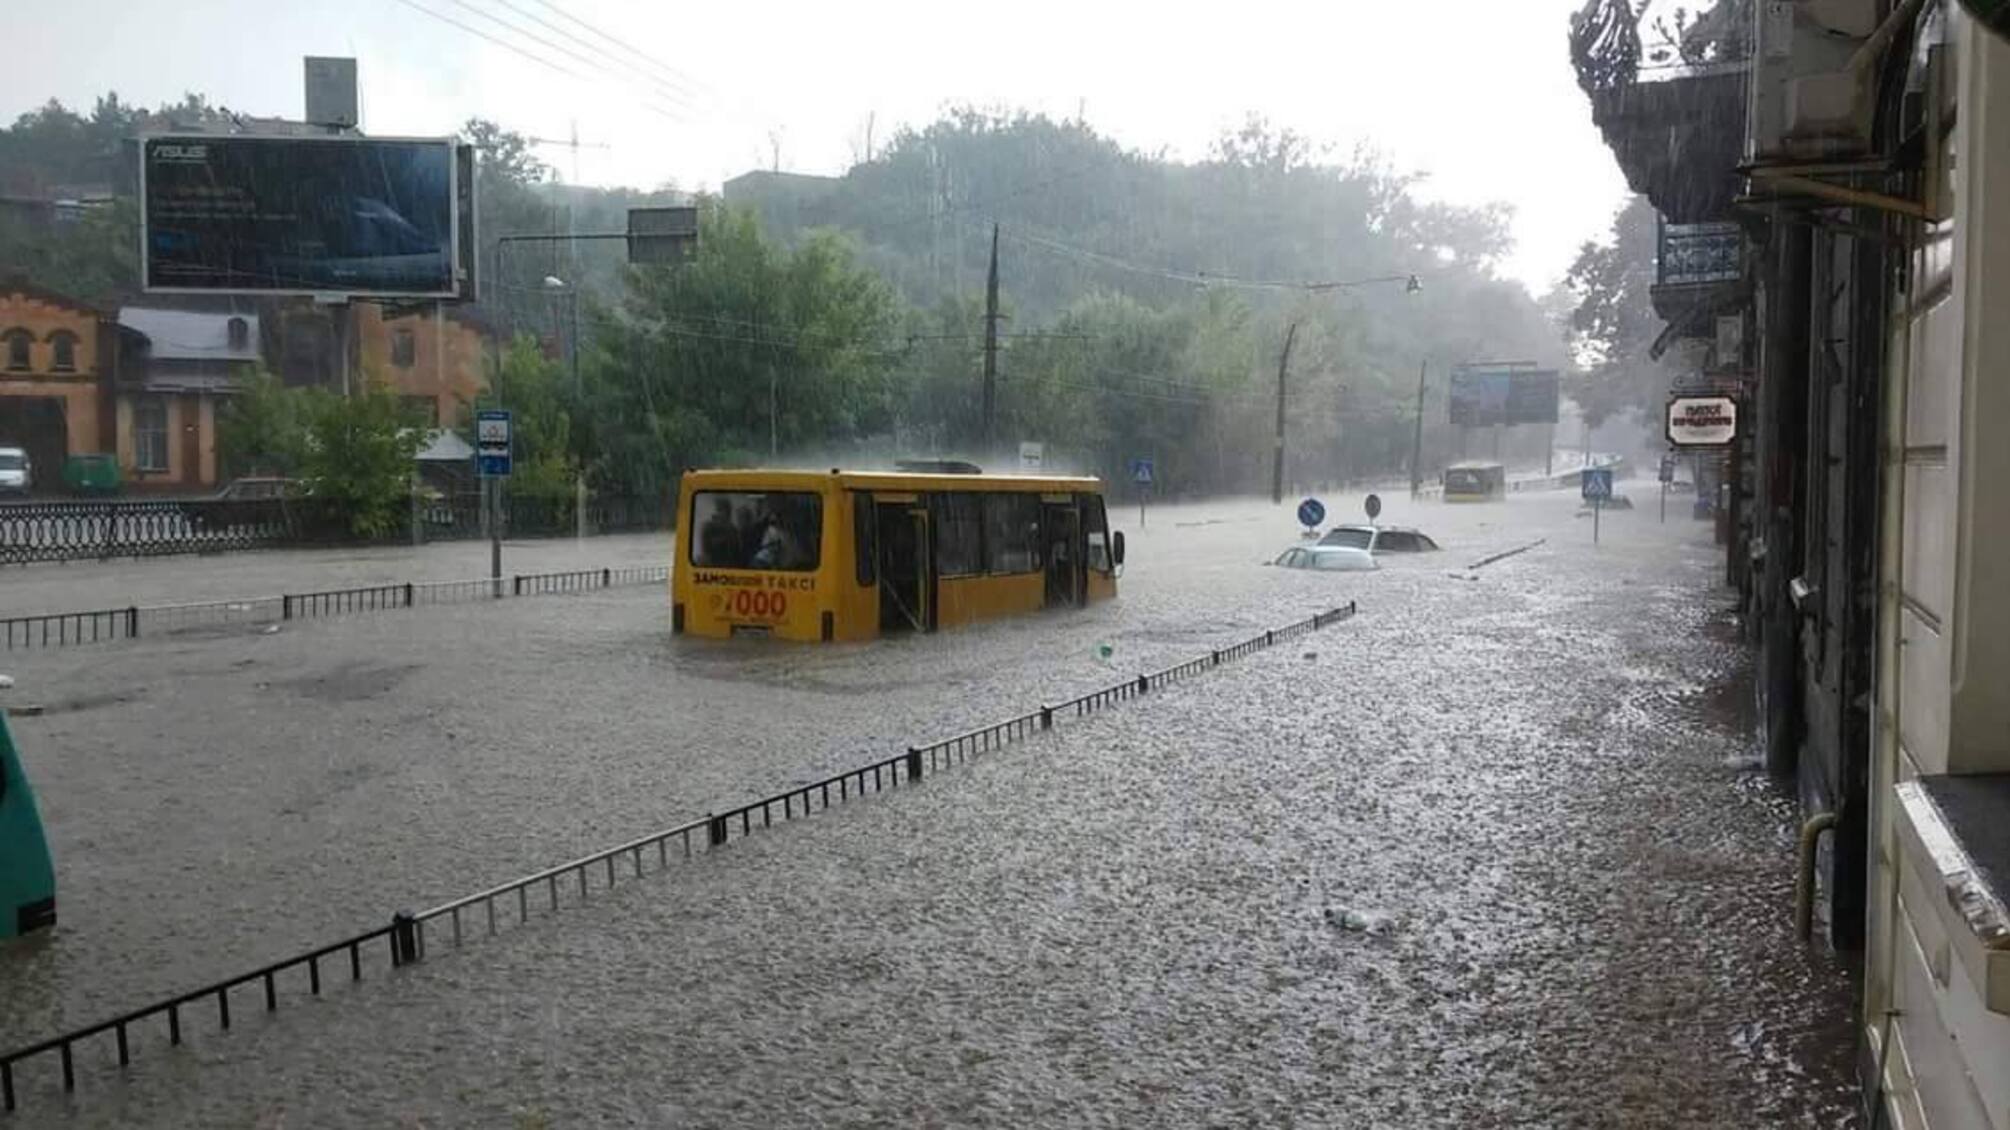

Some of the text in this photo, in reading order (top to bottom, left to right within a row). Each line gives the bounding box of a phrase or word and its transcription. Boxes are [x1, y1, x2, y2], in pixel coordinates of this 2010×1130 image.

[153, 145, 207, 158] ASUS
[693, 572, 816, 592] ЗАМО ТАКСІ
